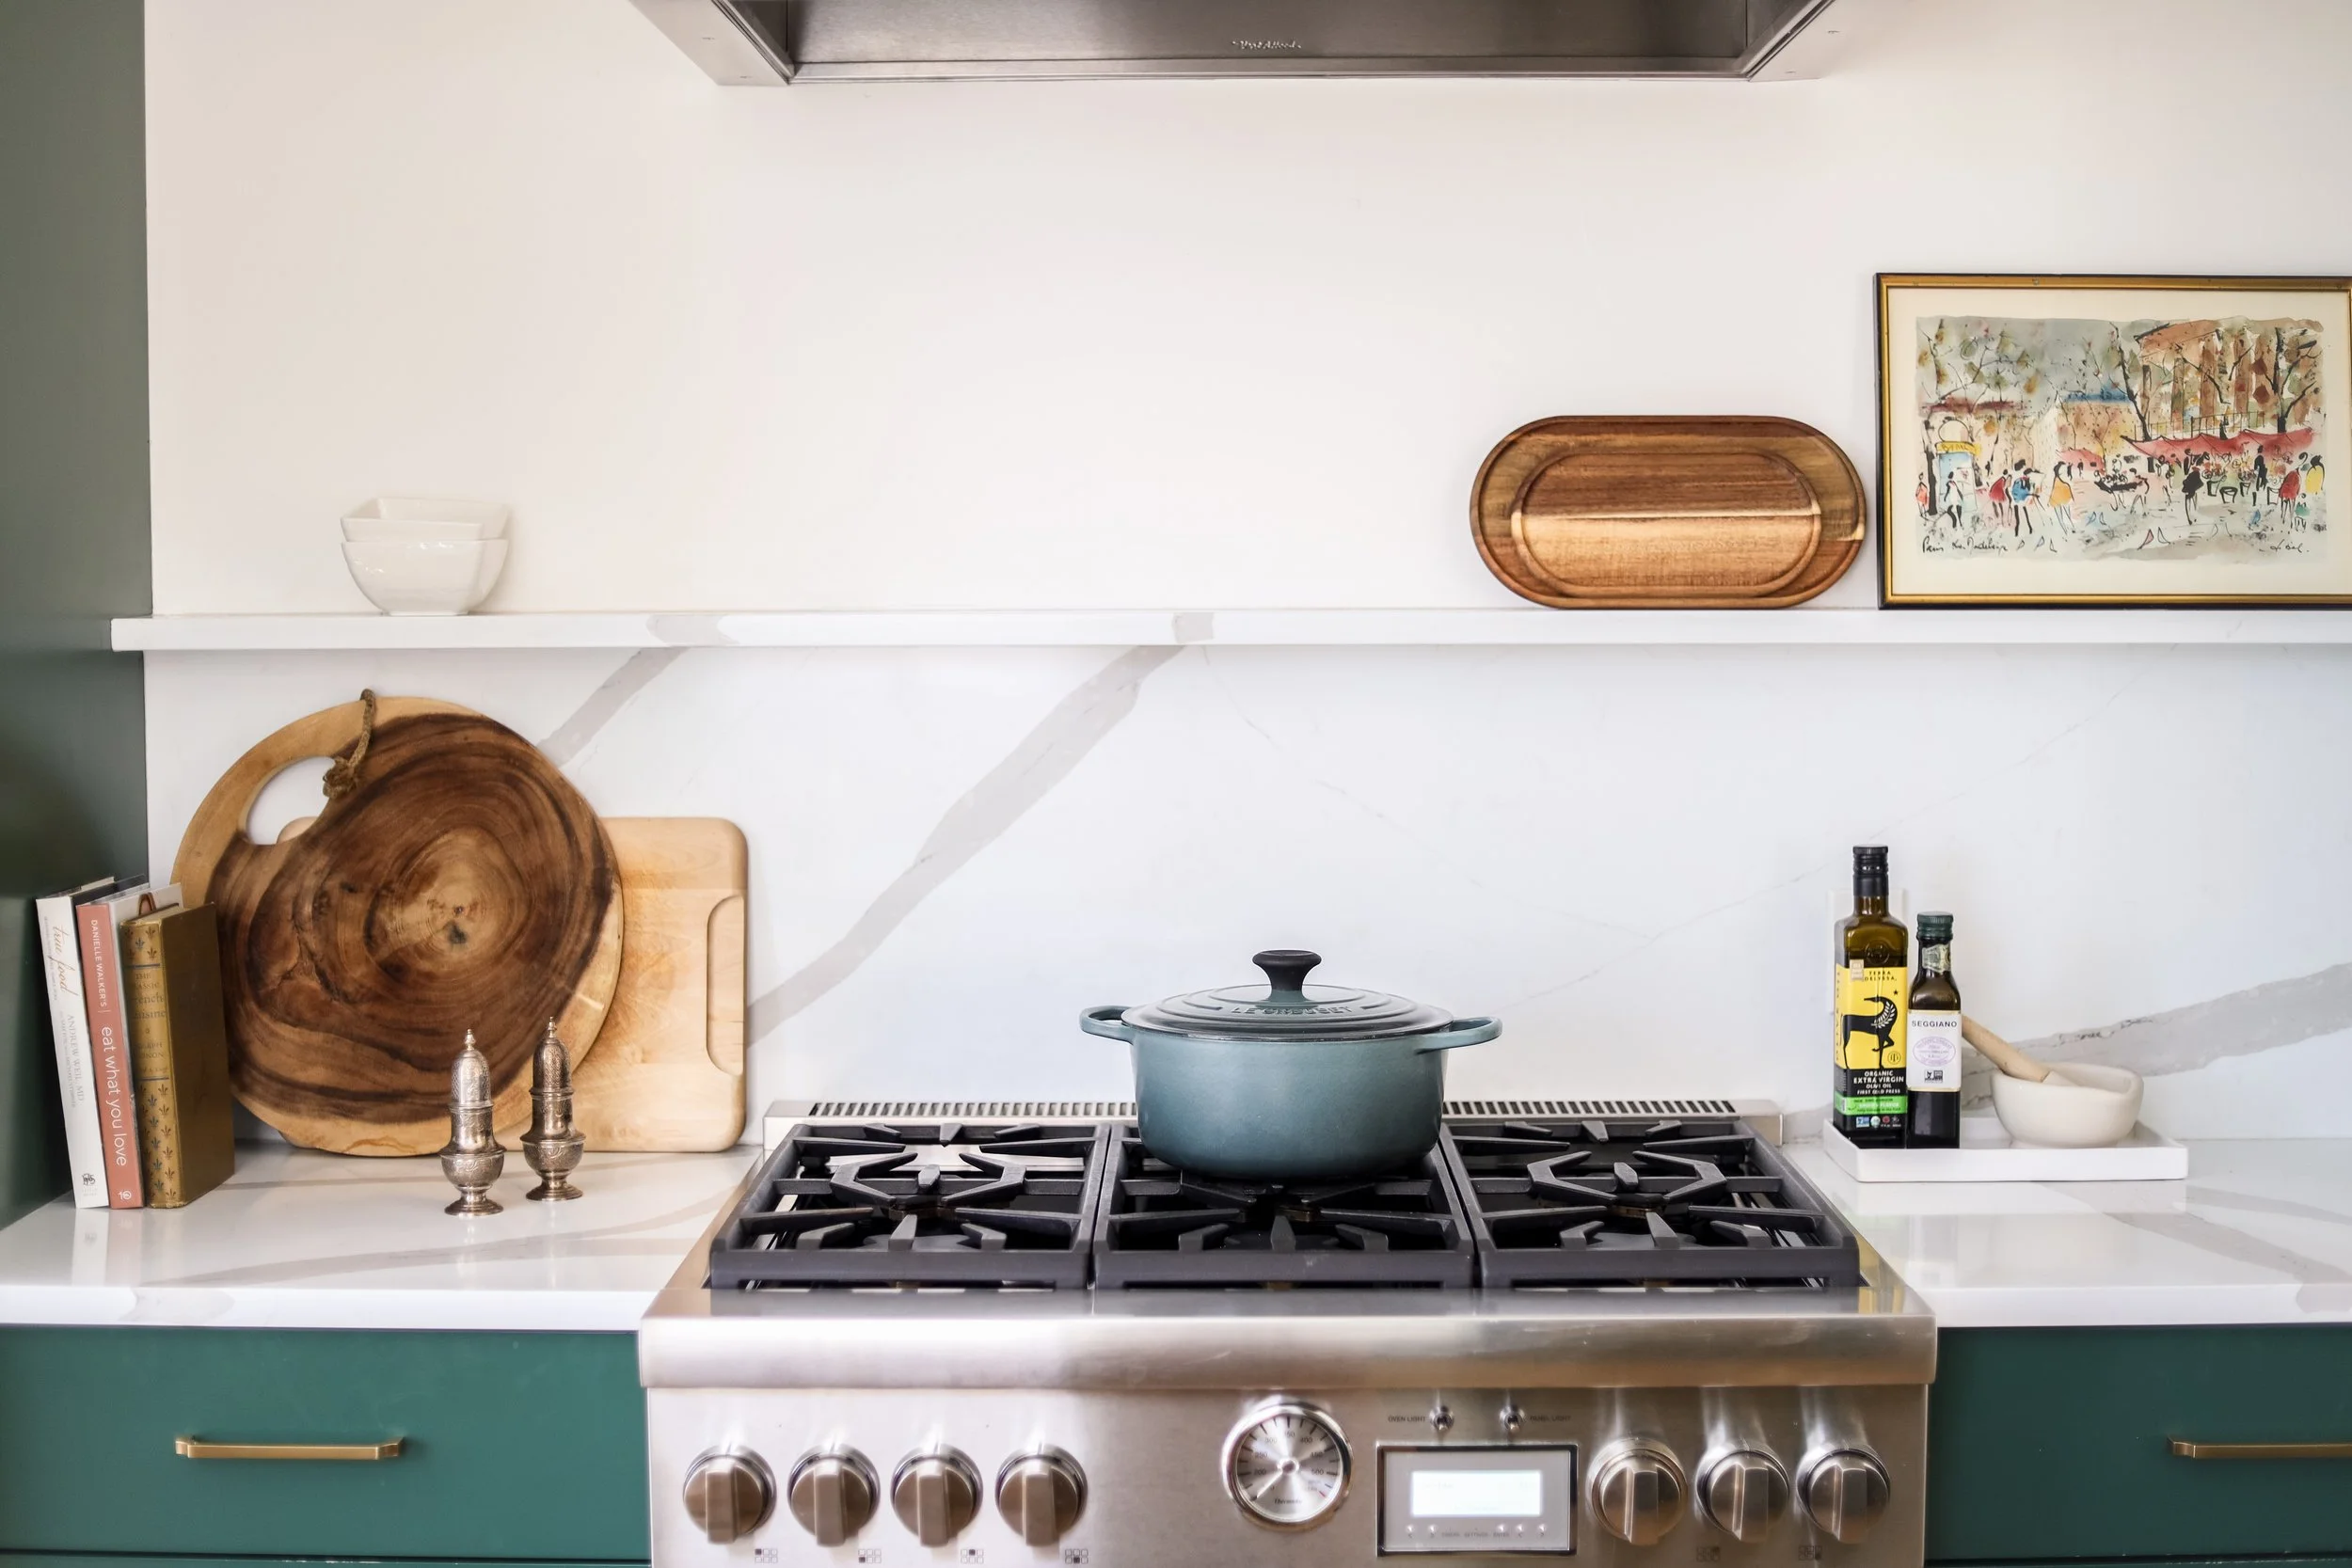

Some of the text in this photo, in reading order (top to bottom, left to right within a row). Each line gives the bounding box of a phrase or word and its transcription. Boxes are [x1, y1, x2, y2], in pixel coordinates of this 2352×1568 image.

[48, 955, 79, 996] food
[91, 920, 107, 1007] DANIELLE WALKER'S
[1262, 1006, 1352, 1015] CREUSET
[67, 1015, 79, 1057] ANDREW
[102, 1026, 128, 1166] eat what you love
